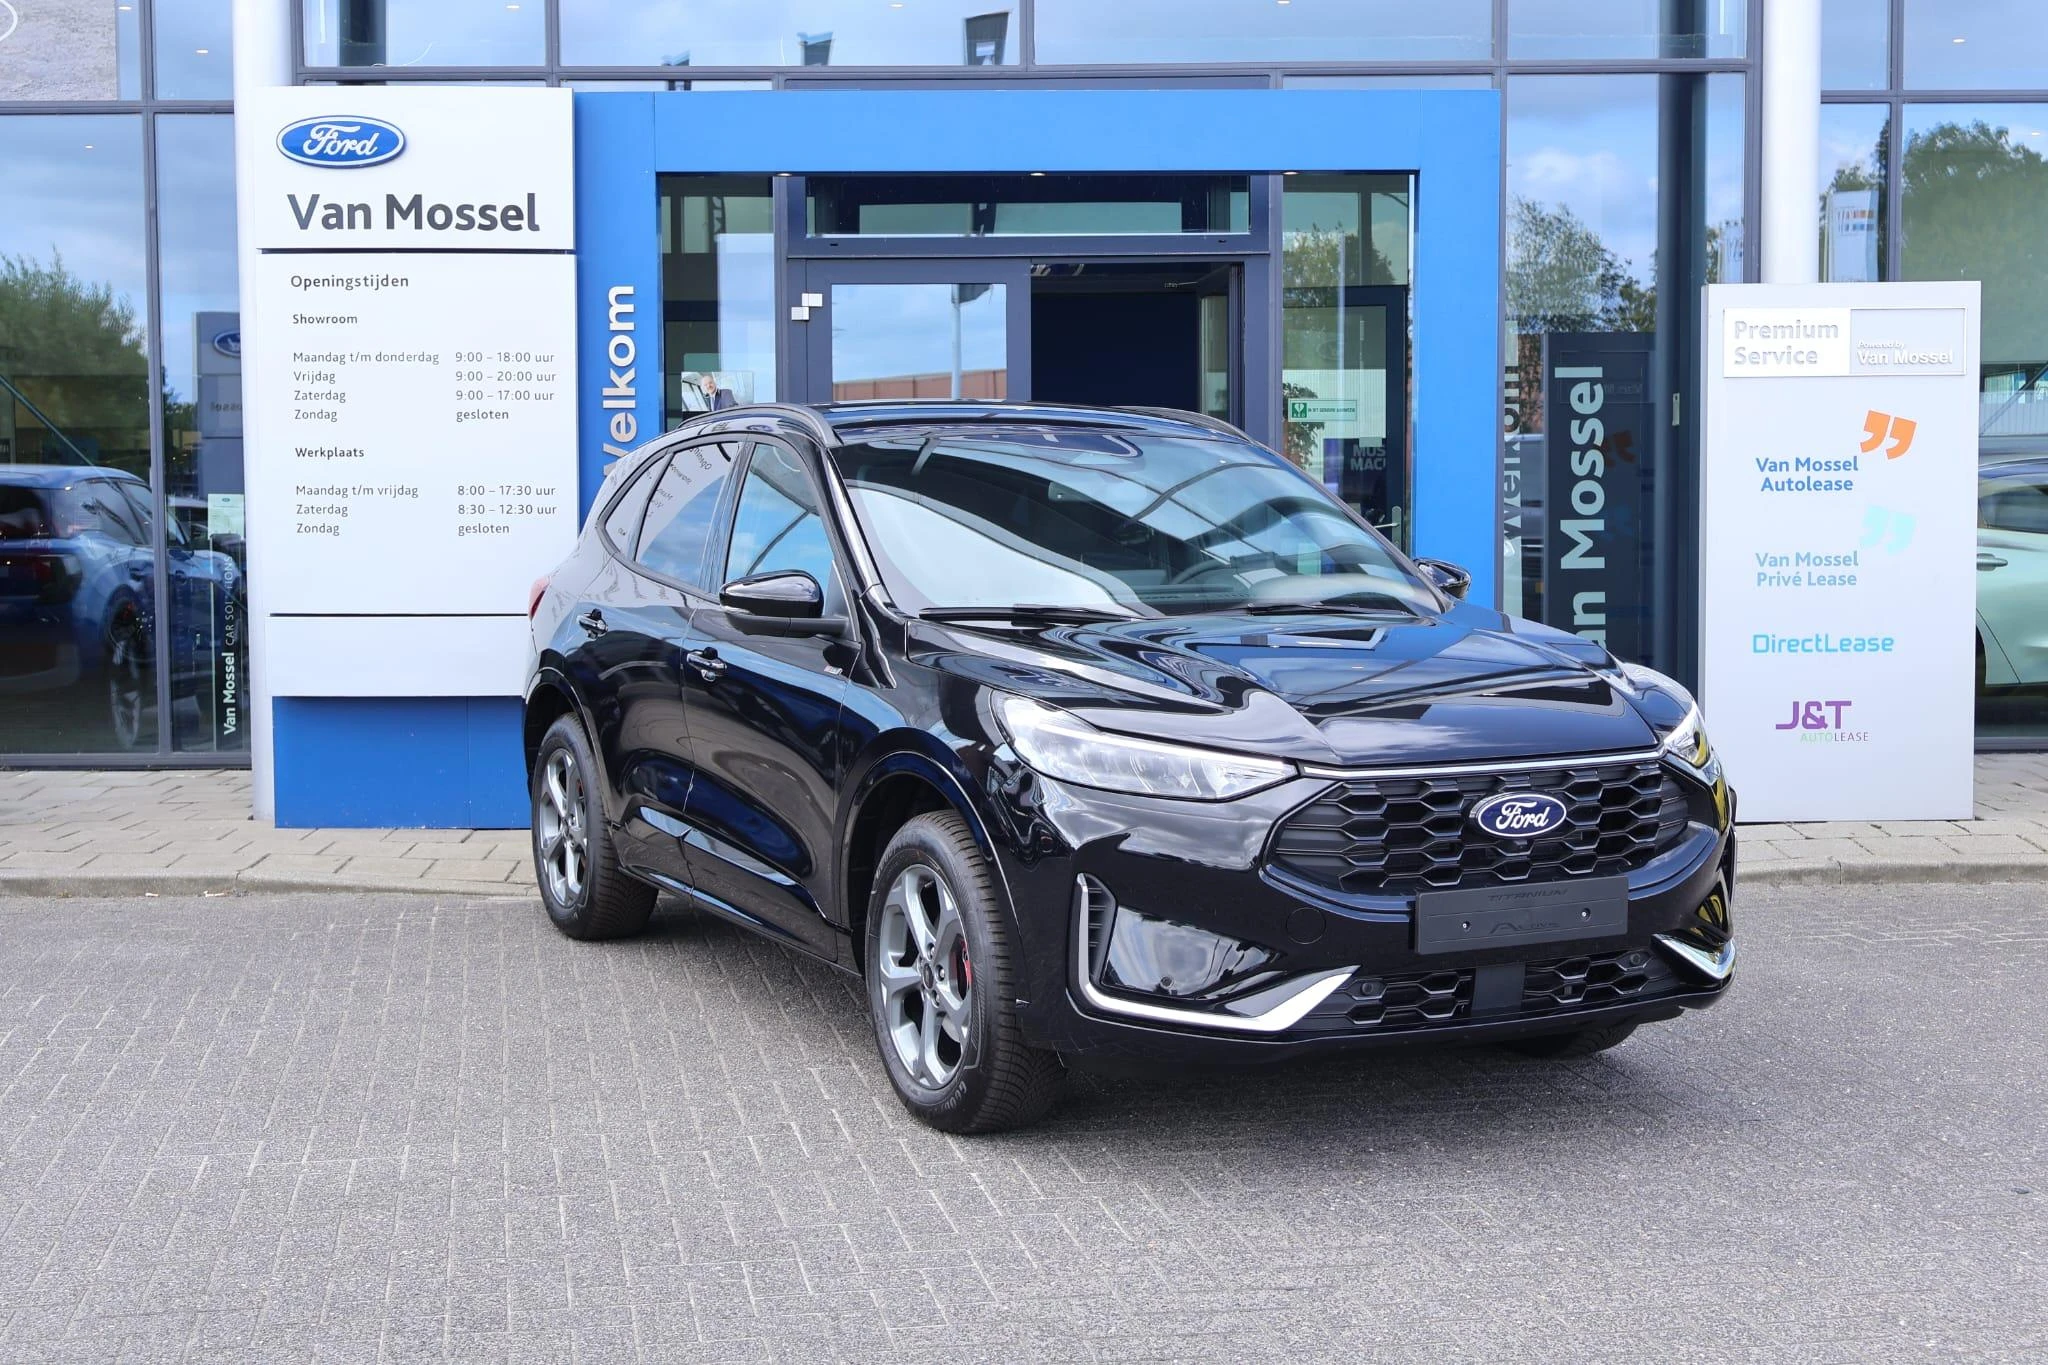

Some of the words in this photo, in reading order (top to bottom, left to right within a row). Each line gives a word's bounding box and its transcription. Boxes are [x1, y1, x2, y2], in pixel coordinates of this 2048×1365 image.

[302, 123, 380, 156] Ford
[286, 193, 372, 231] Van
[385, 192, 541, 232] Mossel
[290, 274, 409, 292] Openingstijden
[292, 313, 358, 325] Showroom
[1734, 319, 1839, 340] Premium
[293, 352, 346, 365] Maandag
[349, 352, 371, 362] t/m
[375, 352, 440, 366] donderdag
[455, 352, 483, 363] 9:00
[497, 352, 531, 363] 18:00
[535, 354, 555, 363] uur
[1734, 346, 1819, 365] Service
[1857, 349, 1889, 365] Van
[1893, 349, 1954, 365] Mossel
[293, 371, 336, 384] Vrijdag
[455, 371, 483, 382] 9:00
[497, 371, 532, 382] 20:00
[536, 373, 557, 382] uur
[294, 390, 346, 403] Zaterdag
[455, 390, 483, 401] 9:00
[498, 390, 531, 401] 17:00
[534, 392, 554, 401] uur
[294, 409, 337, 422] Zondag
[456, 409, 510, 422] gesloten
[295, 447, 365, 460] Werkplaats
[1554, 366, 1606, 569] Mossel
[1756, 457, 1790, 472] Van
[1795, 455, 1859, 472] Mossel
[296, 485, 349, 498] Maandag
[352, 485, 374, 496] t/m
[377, 485, 419, 498] vrijdag
[457, 485, 485, 496] 8:00
[499, 485, 532, 496] 17:30
[536, 487, 556, 496] uur
[1760, 476, 1854, 492] Autolease
[296, 504, 349, 518] Zaterdag
[457, 504, 486, 515] 8:30
[500, 504, 533, 515] 12:30
[537, 506, 558, 515] uur
[296, 523, 340, 536] Zondag
[457, 523, 510, 537] gesloten
[1755, 552, 1790, 567] Van
[1795, 551, 1859, 567] Mossel
[1757, 571, 1802, 587] Privé
[1807, 572, 1857, 587] Lease
[1572, 591, 1607, 649] an
[225, 624, 235, 646] CAR
[1753, 634, 1894, 653] DirectLease
[222, 652, 235, 704] Mossel
[223, 706, 236, 735] Van
[1775, 700, 1852, 730] J&T
[1800, 731, 1869, 743] AUTOLEASE
[1495, 801, 1551, 830] Ford
